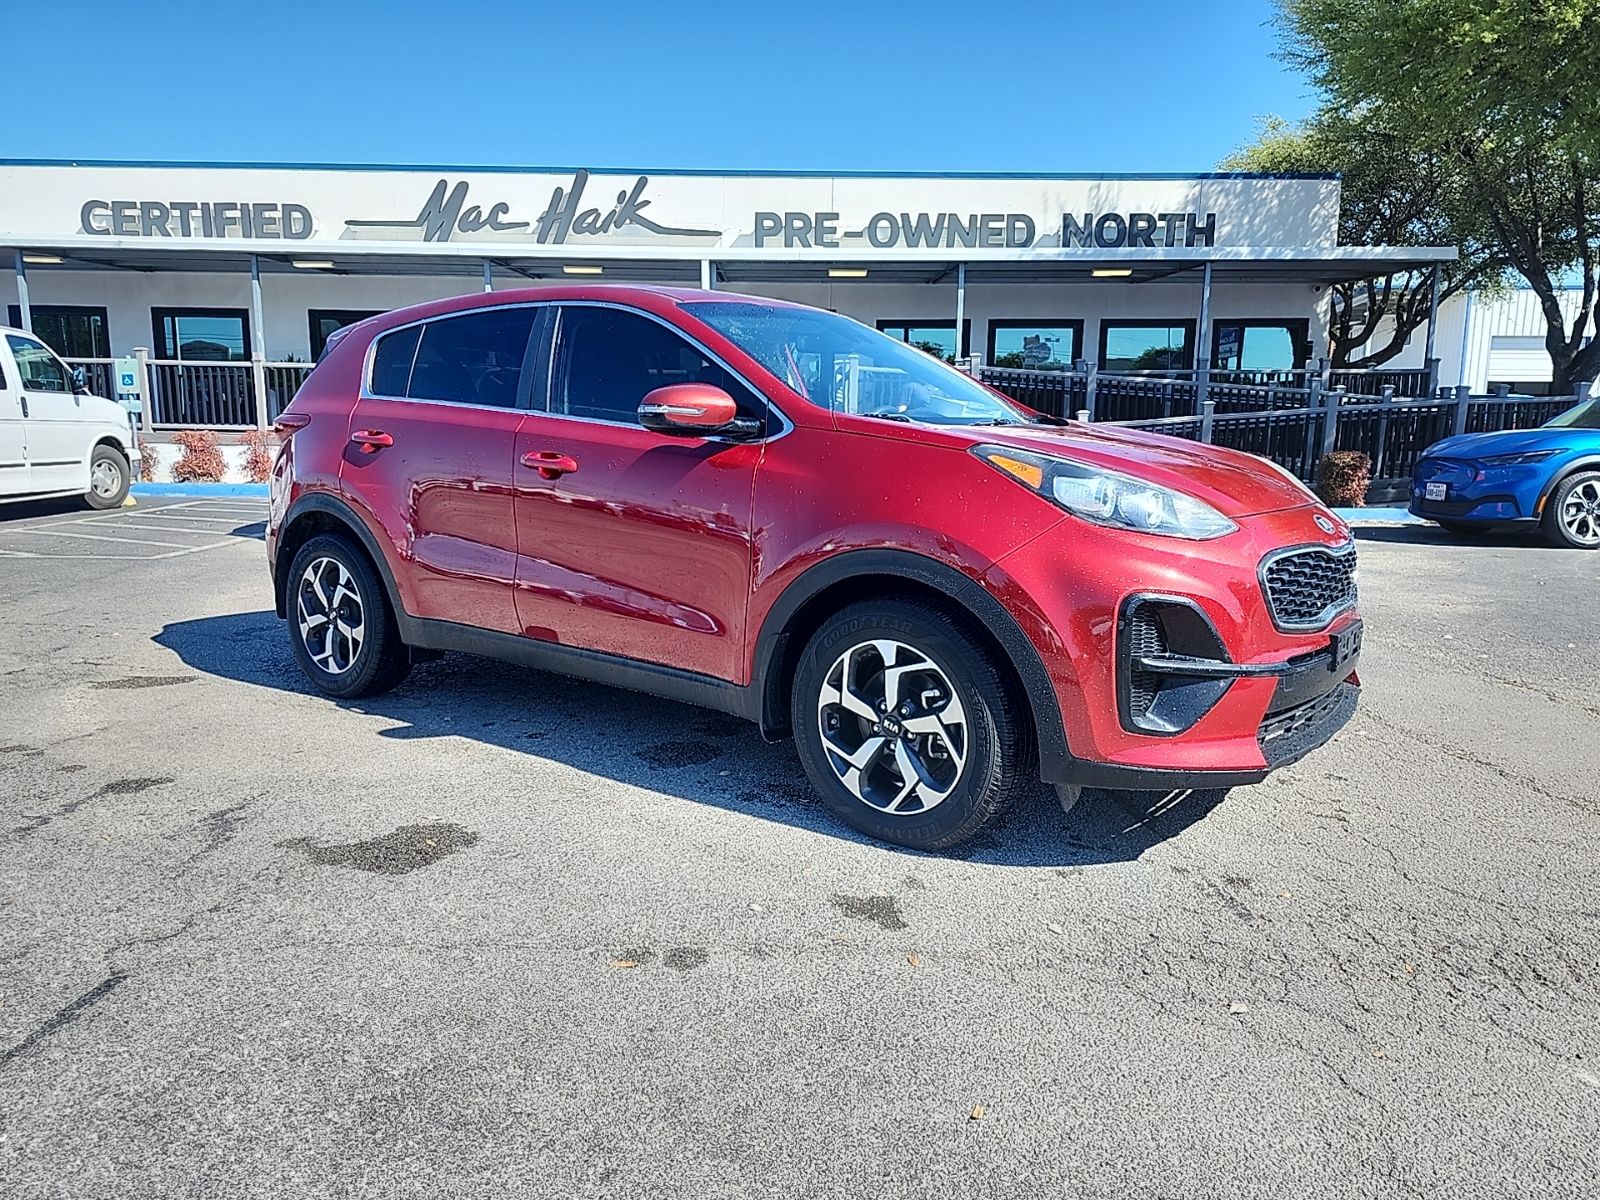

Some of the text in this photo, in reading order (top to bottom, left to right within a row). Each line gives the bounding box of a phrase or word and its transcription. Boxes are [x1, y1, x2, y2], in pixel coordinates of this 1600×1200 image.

[80, 168, 1217, 248] CERTIFIED Mac Haik PRE-OWNED NORTH
[883, 719, 899, 734] KIA
